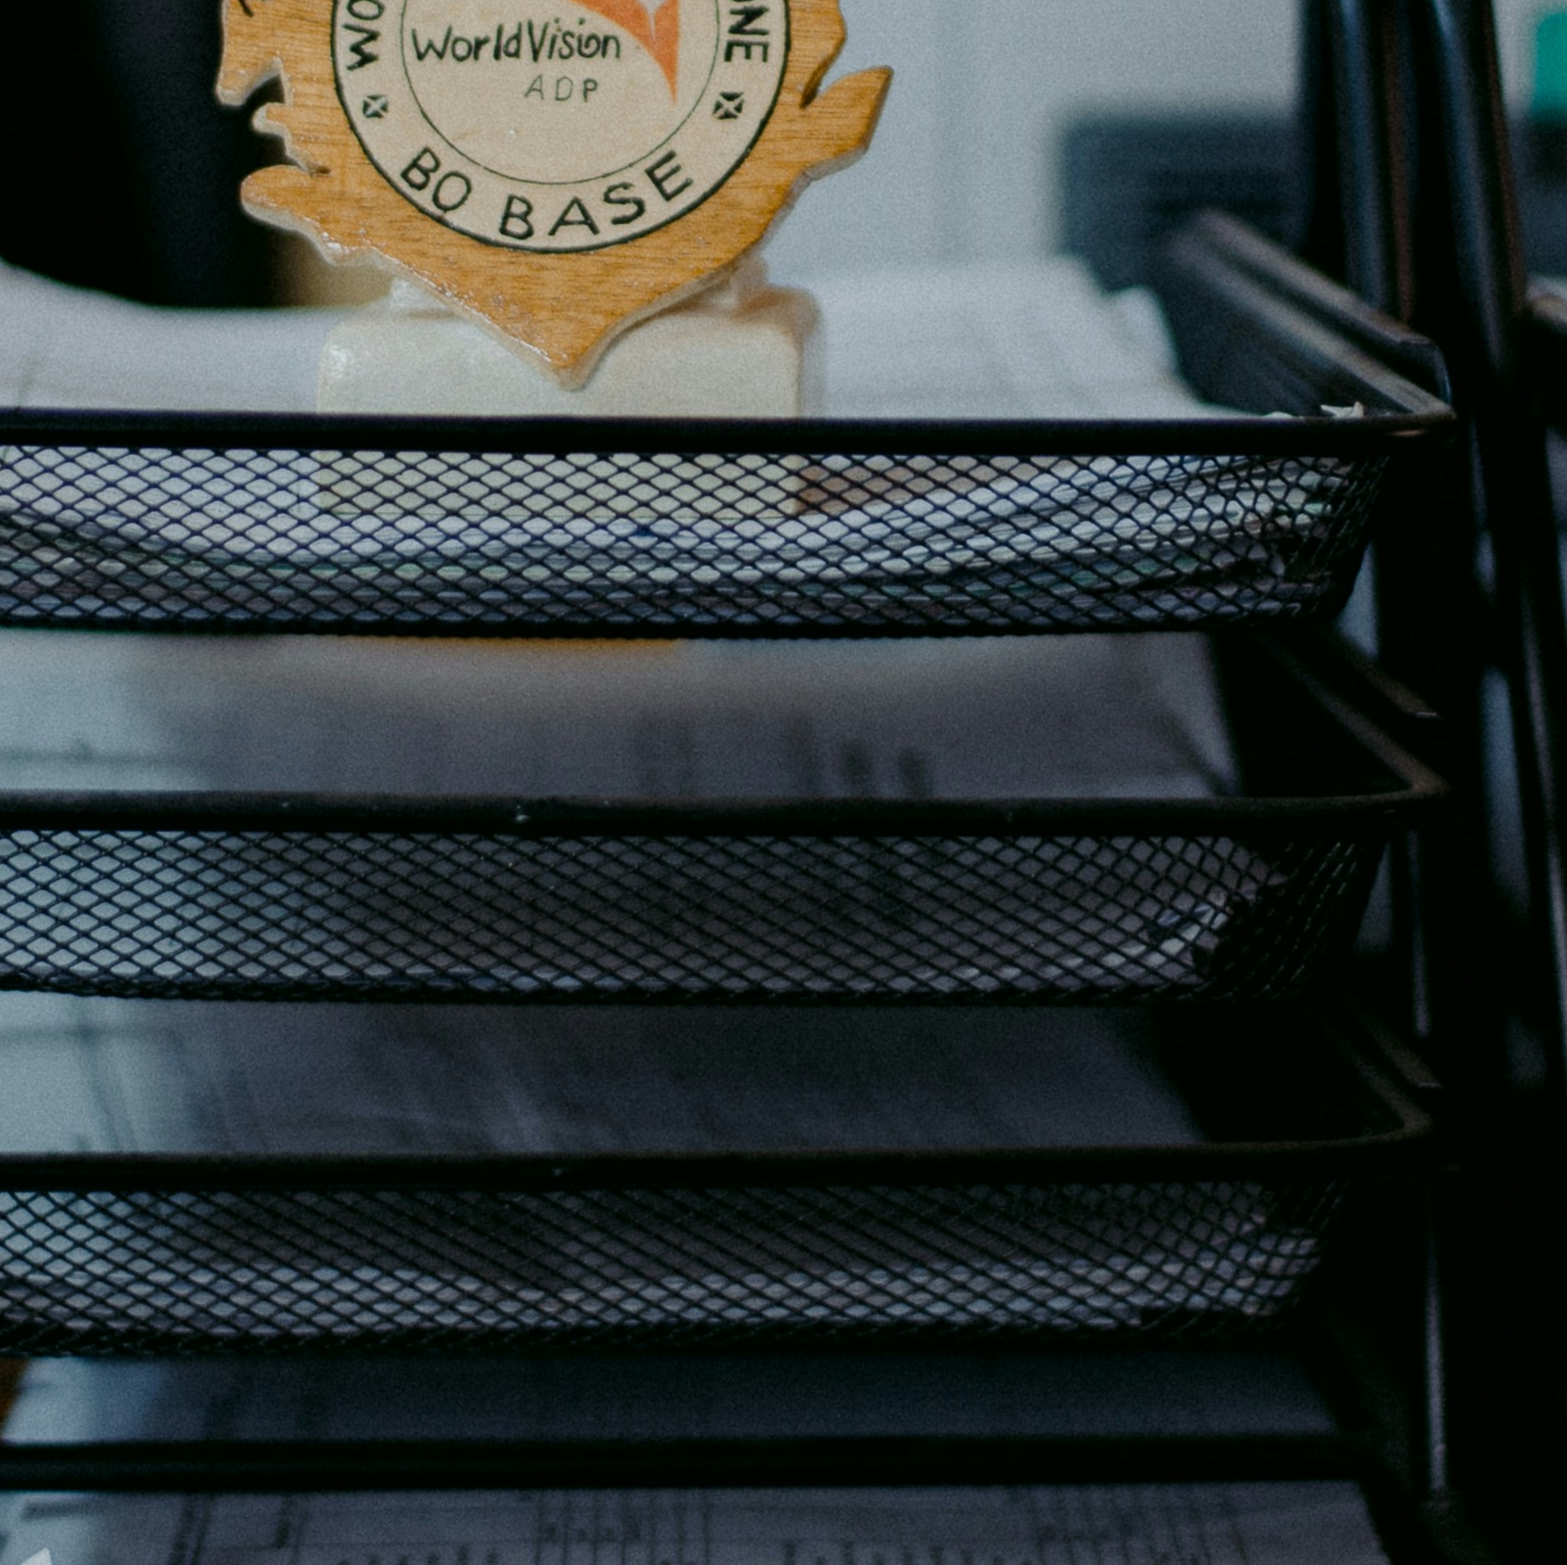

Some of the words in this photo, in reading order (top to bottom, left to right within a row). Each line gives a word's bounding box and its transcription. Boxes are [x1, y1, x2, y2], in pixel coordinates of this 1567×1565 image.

[524, 73, 599, 103] ADP
[400, 146, 473, 213] BO
[499, 149, 694, 240] BASE
